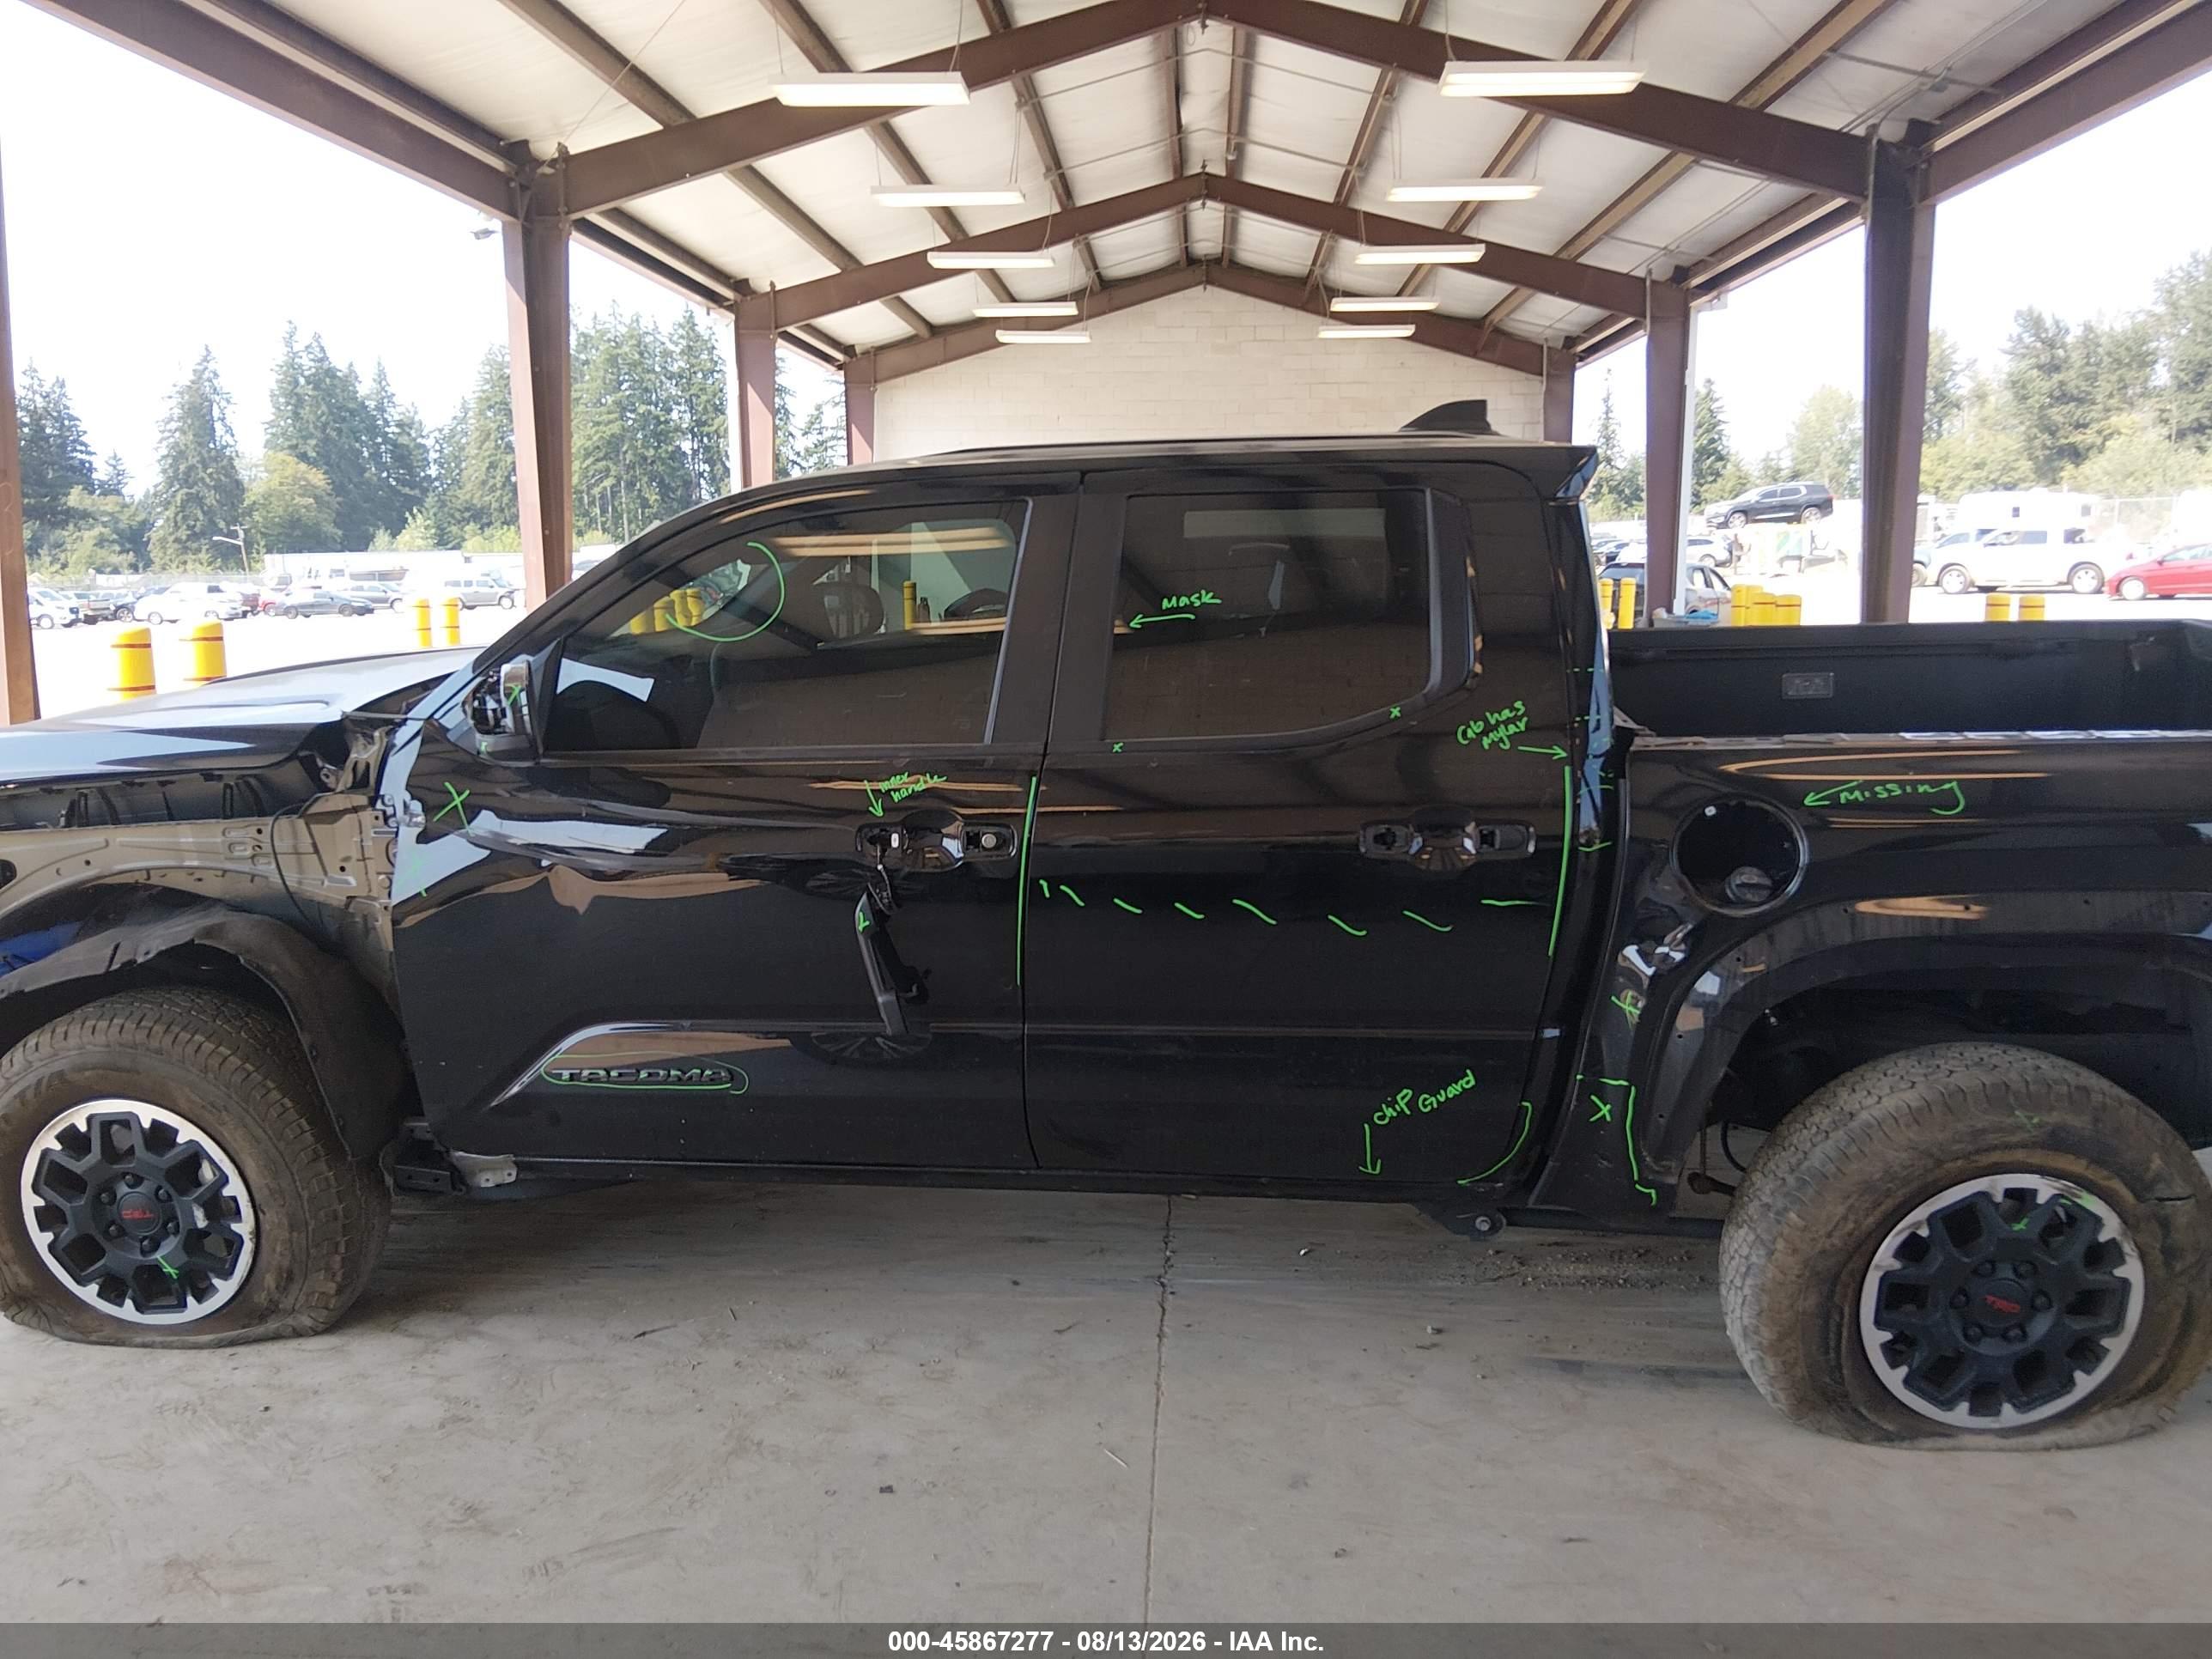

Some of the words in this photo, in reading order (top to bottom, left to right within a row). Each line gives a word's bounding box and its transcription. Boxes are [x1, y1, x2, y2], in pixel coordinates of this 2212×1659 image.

[1485, 700, 1526, 725] has
[551, 1069, 732, 1082] TACOMA
[1418, 1069, 1477, 1113] Guard
